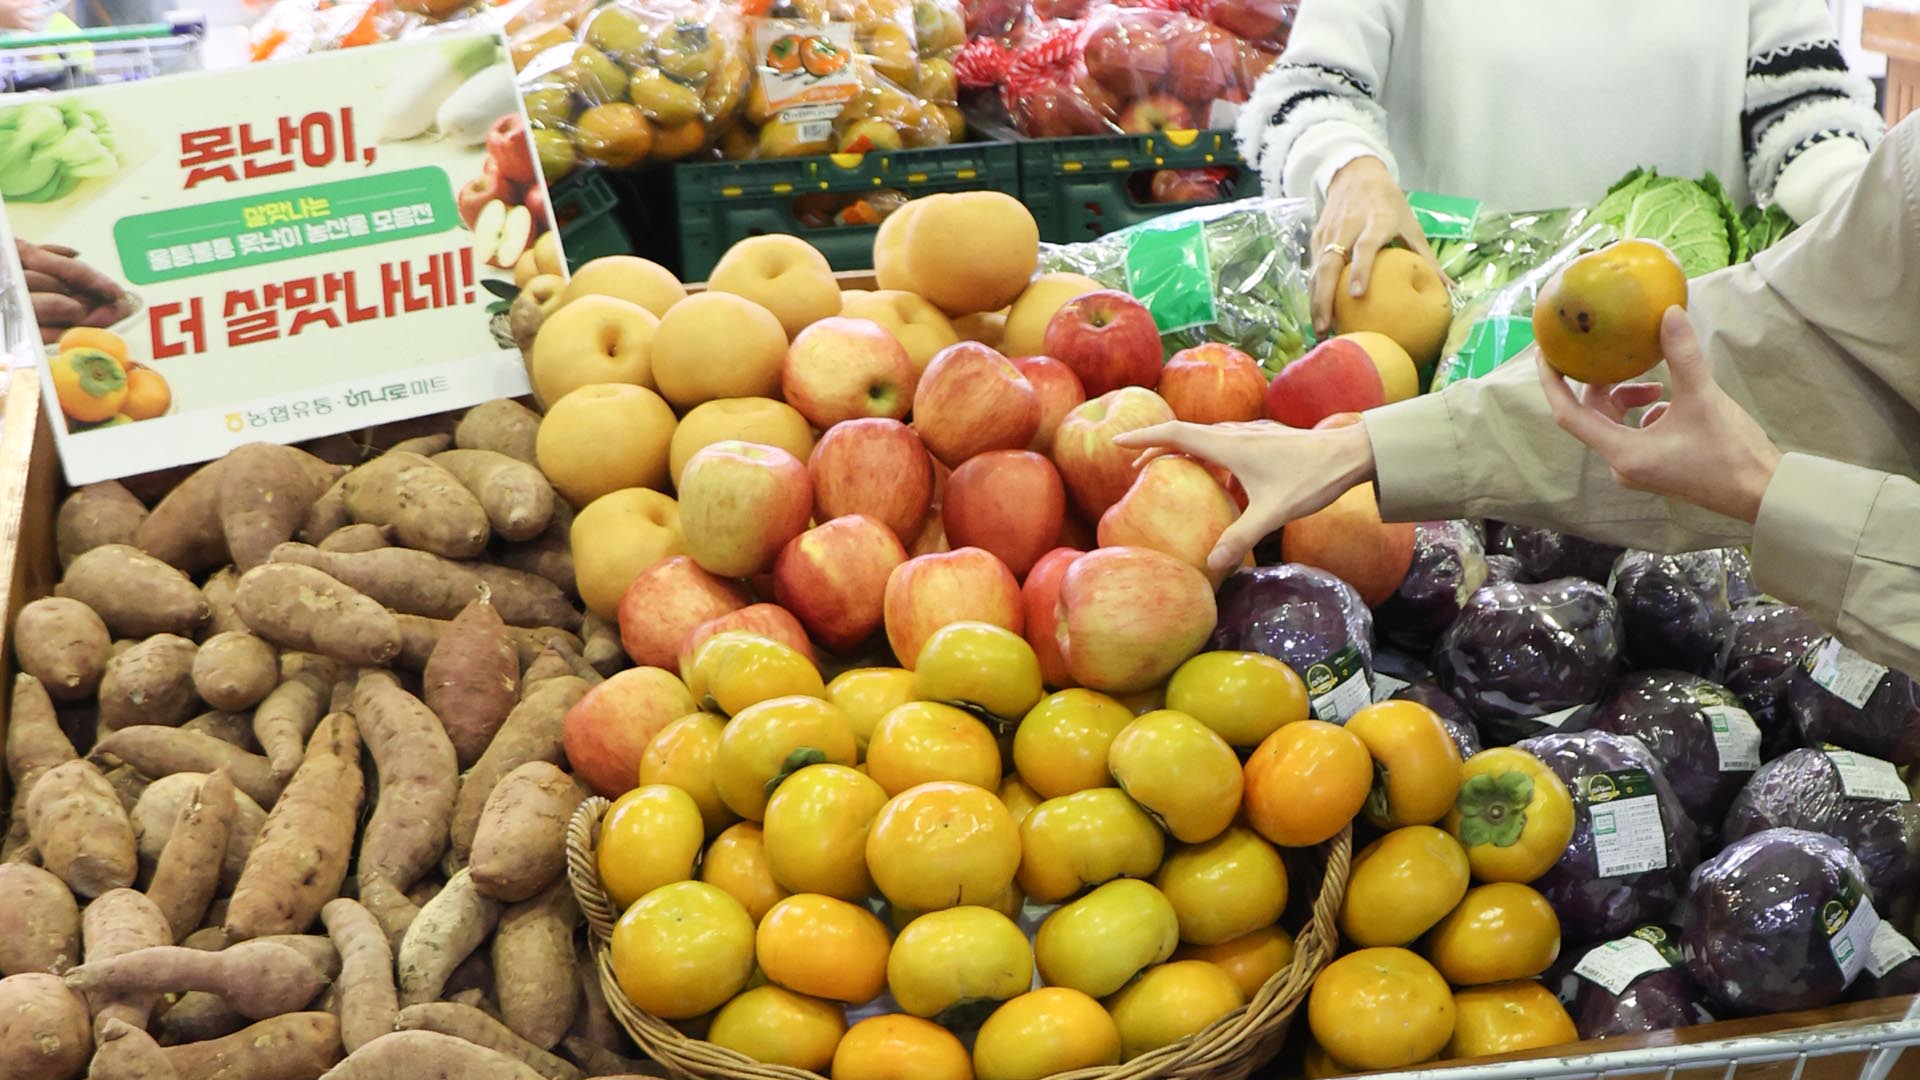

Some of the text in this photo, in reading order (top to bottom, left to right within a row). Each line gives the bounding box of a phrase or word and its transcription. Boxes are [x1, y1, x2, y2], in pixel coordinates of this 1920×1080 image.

[180, 106, 378, 190] 못난이,
[236, 225, 304, 257] 못난이
[304, 213, 371, 245] 농산물
[371, 202, 436, 233] 모음전
[149, 246, 477, 360] 더 살맛나네!
